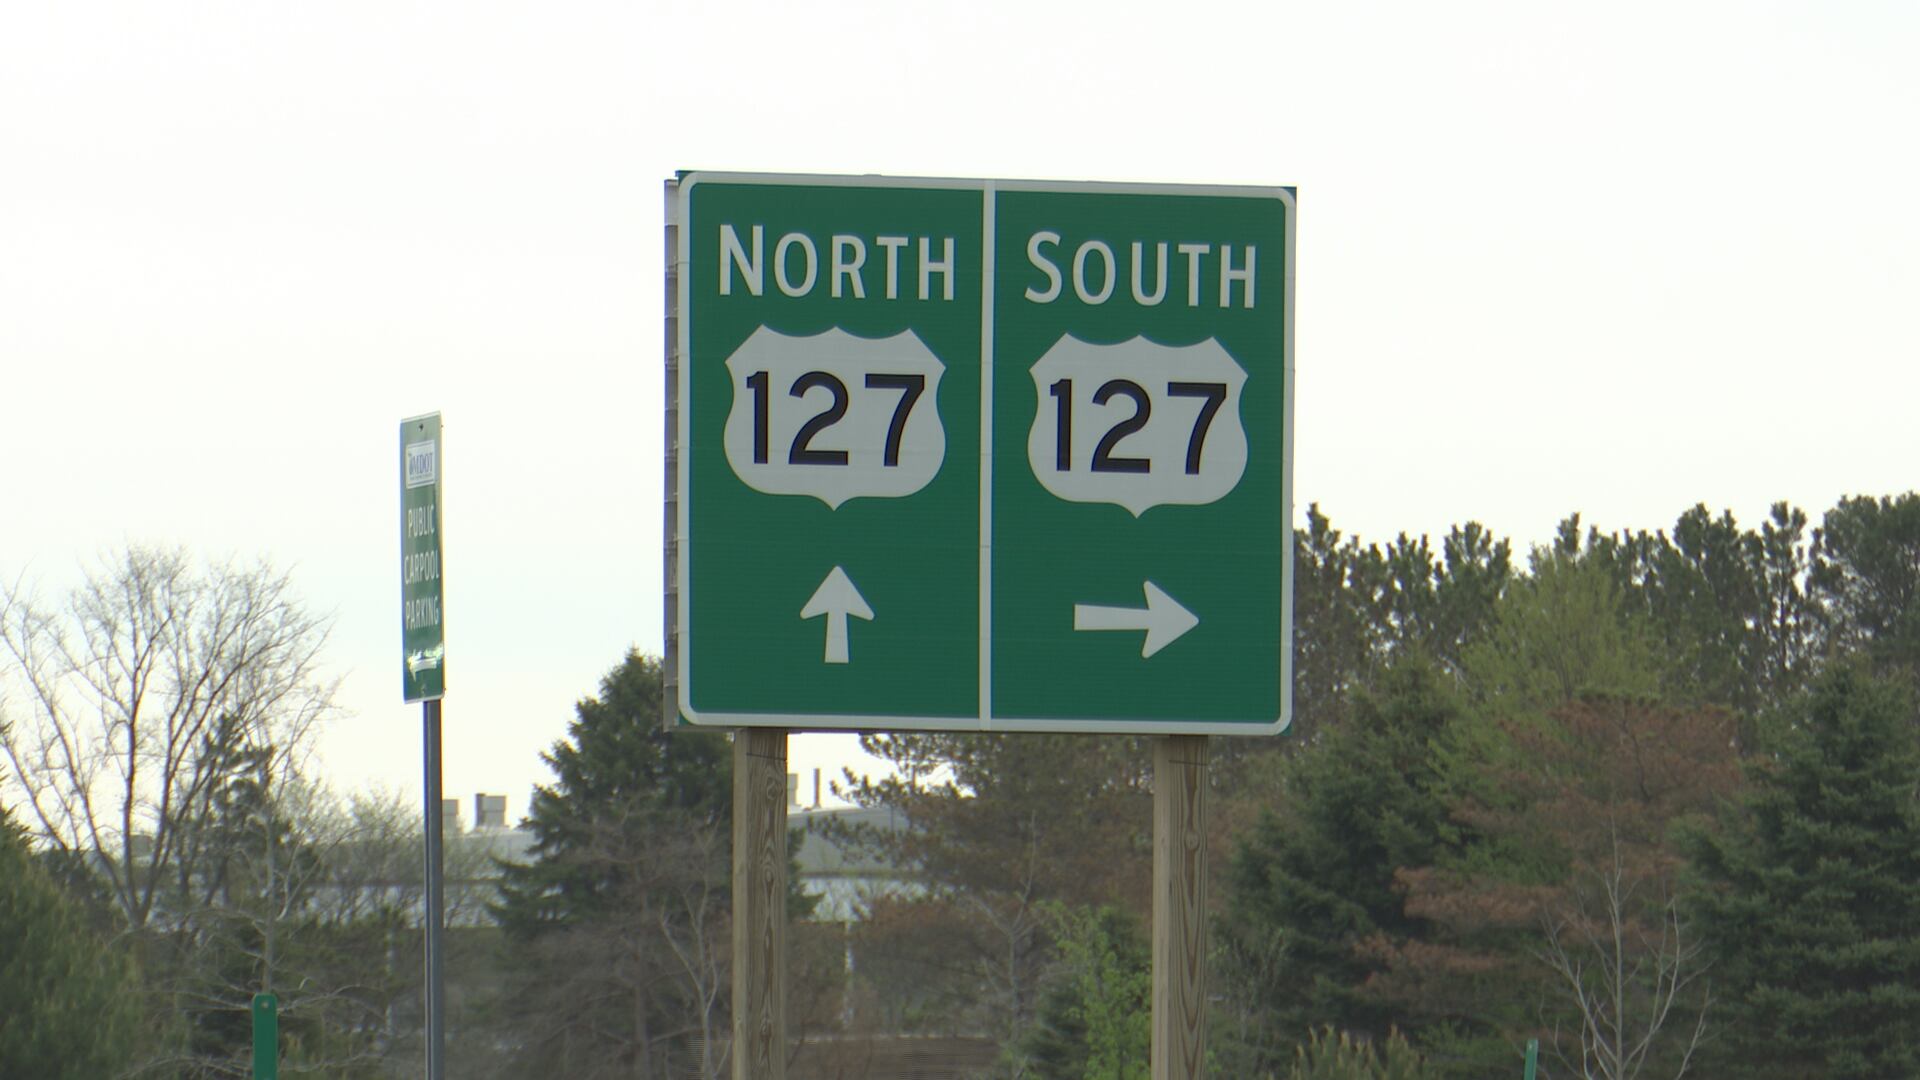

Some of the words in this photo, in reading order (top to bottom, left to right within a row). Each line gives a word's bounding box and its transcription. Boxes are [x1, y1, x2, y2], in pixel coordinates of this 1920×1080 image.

[719, 224, 955, 301] NORTH
[1025, 231, 1257, 309] SOUTH
[746, 370, 926, 467] 127
[1049, 378, 1228, 475] 127
[408, 503, 435, 538] PUBLIC
[404, 551, 440, 585] CARPOOL
[406, 597, 438, 631] PARKING
